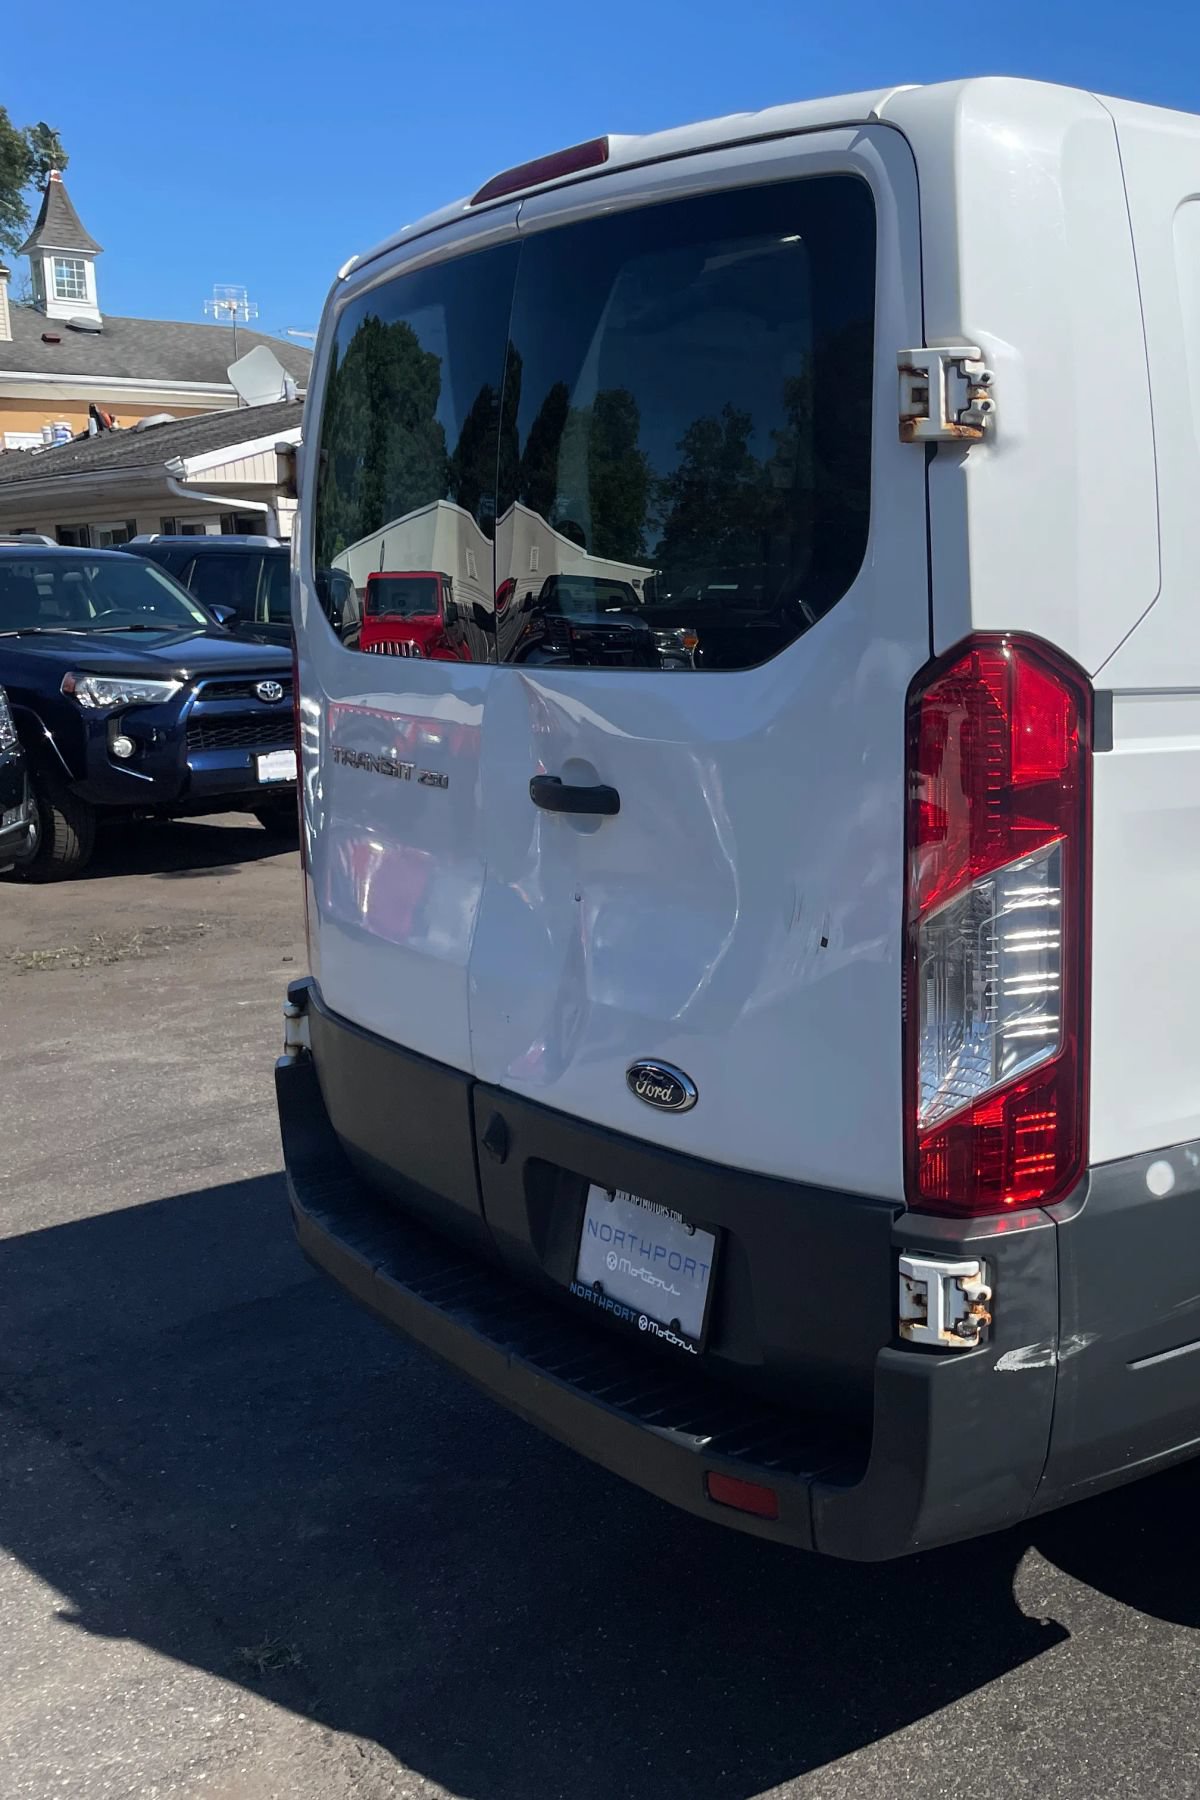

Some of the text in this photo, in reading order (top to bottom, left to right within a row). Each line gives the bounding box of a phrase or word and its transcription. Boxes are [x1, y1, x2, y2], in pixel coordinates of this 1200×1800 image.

[330, 745, 449, 789] TRANSIT 250
[636, 1070, 674, 1102] Ford
[587, 1218, 710, 1283] NORTHPORT
[569, 1282, 636, 1322] NORTHPORT
